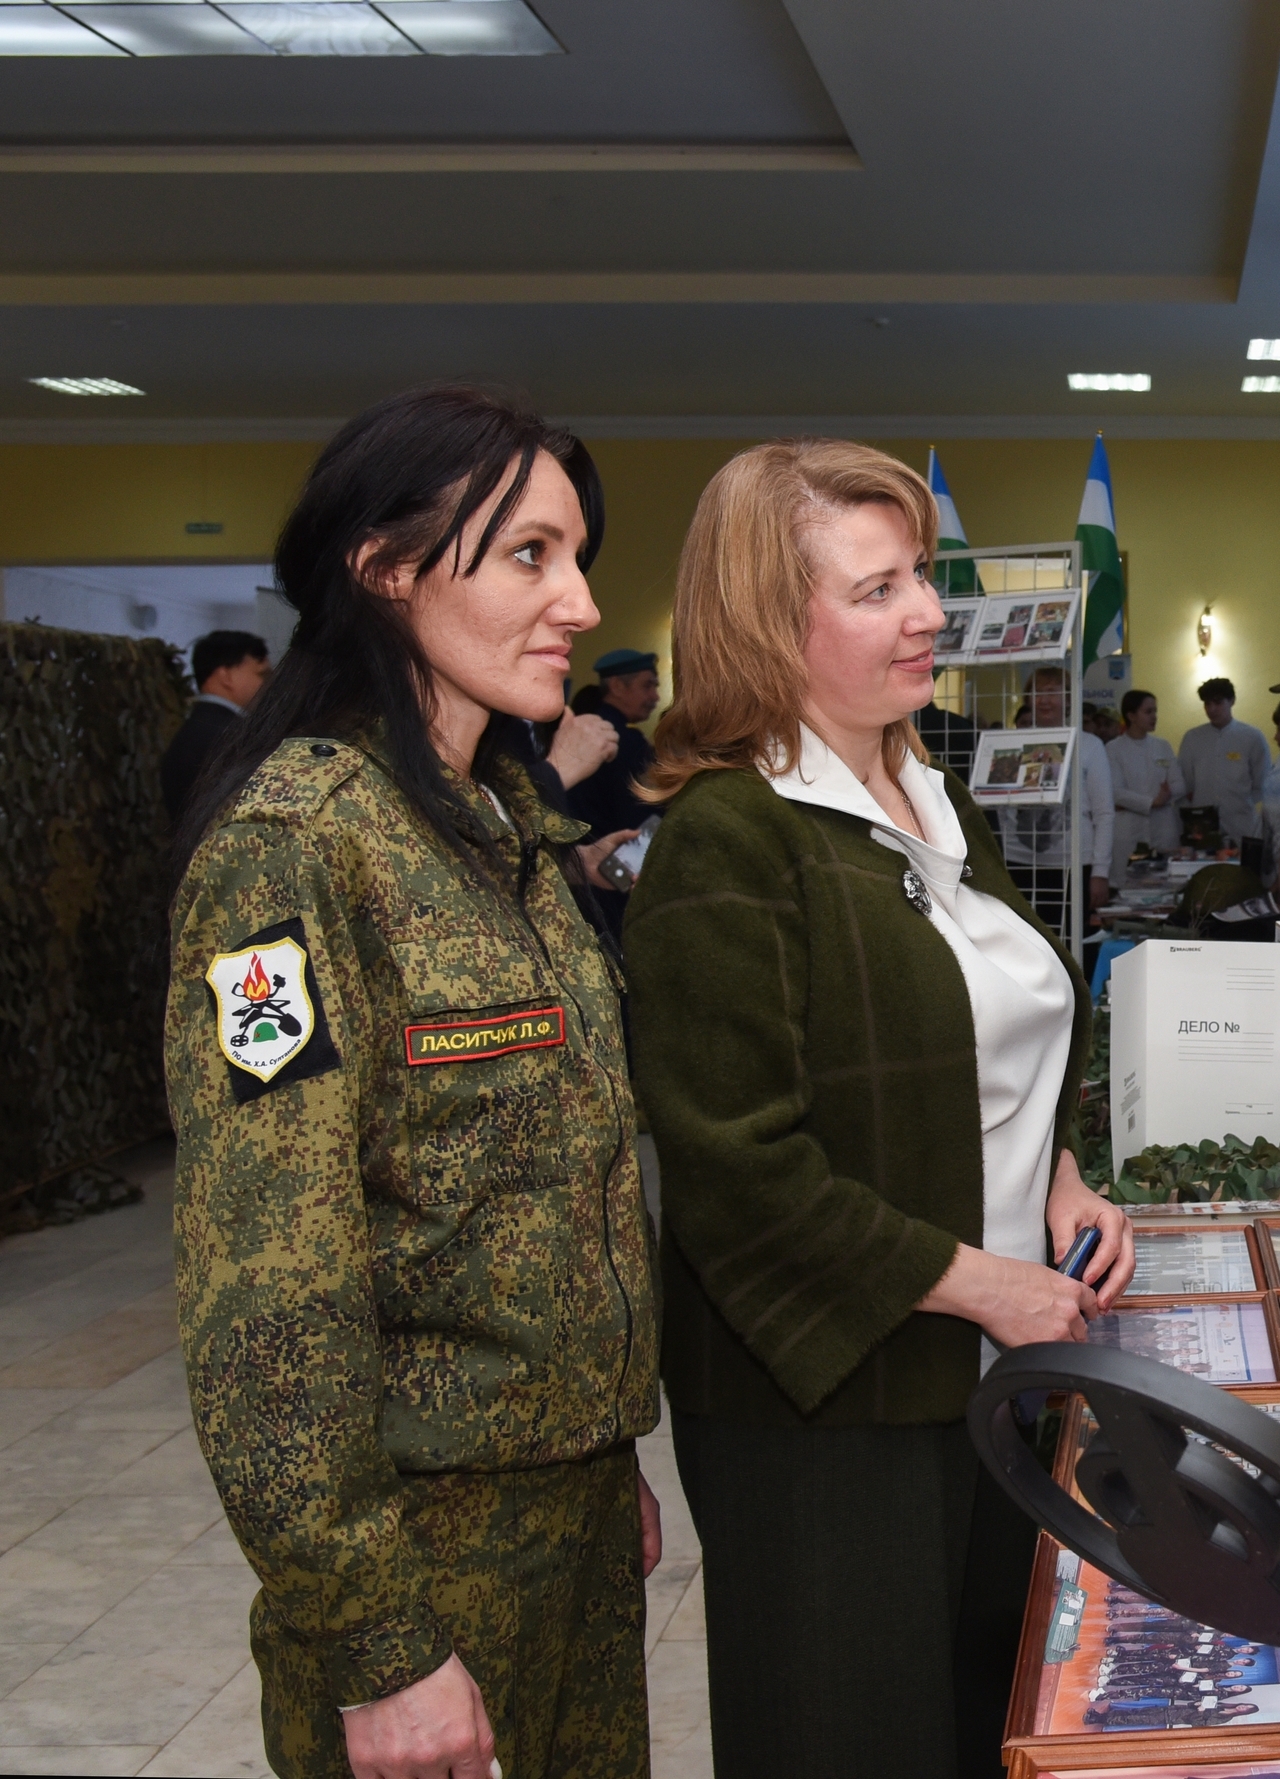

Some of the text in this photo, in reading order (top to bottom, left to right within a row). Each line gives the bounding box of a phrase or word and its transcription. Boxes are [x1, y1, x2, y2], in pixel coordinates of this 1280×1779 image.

[420, 1025, 517, 1053] ЛАСИТЧУК
[1178, 1020, 1240, 1034] ДЕЛО №
[232, 1051, 241, 1060] ПО
[270, 1039, 301, 1065] Султанова
